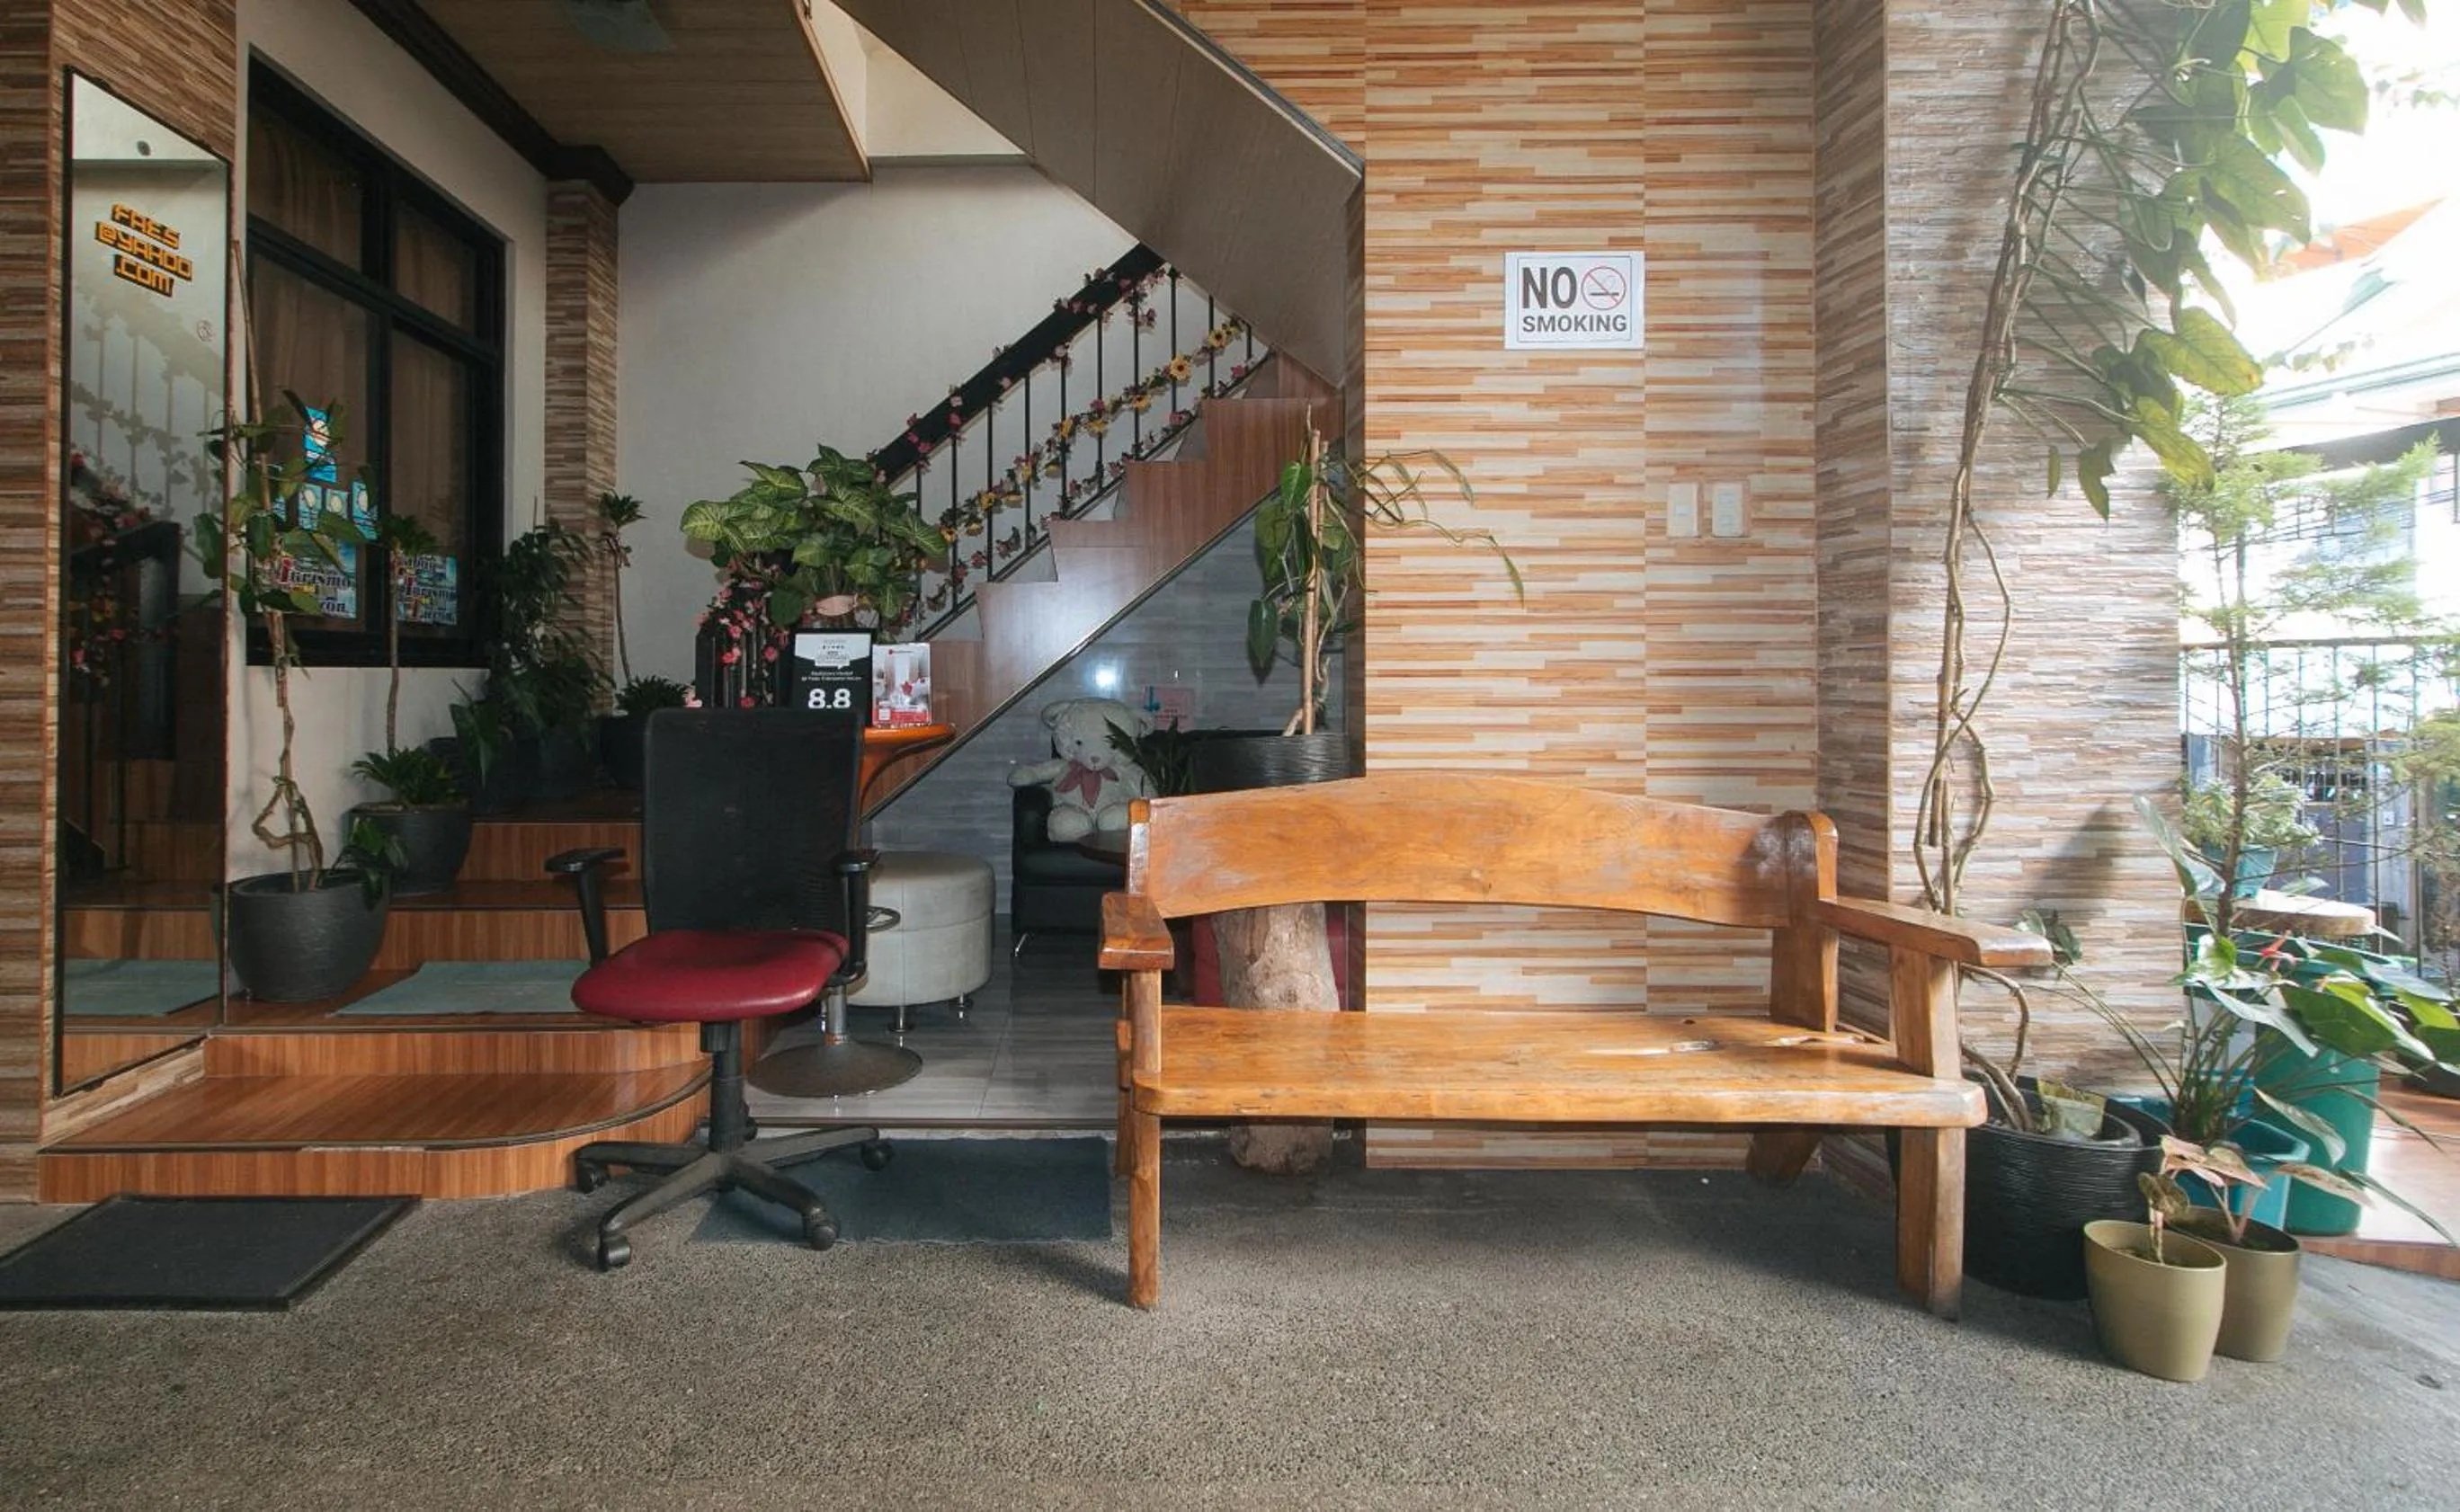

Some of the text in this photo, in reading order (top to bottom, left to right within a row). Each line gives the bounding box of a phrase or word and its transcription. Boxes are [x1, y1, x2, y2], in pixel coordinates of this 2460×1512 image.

[94, 221, 192, 281] @YAHOO
[1522, 267, 1577, 309] NO
[1522, 315, 1627, 332] SMOKING
[808, 689, 851, 708] 8.8
